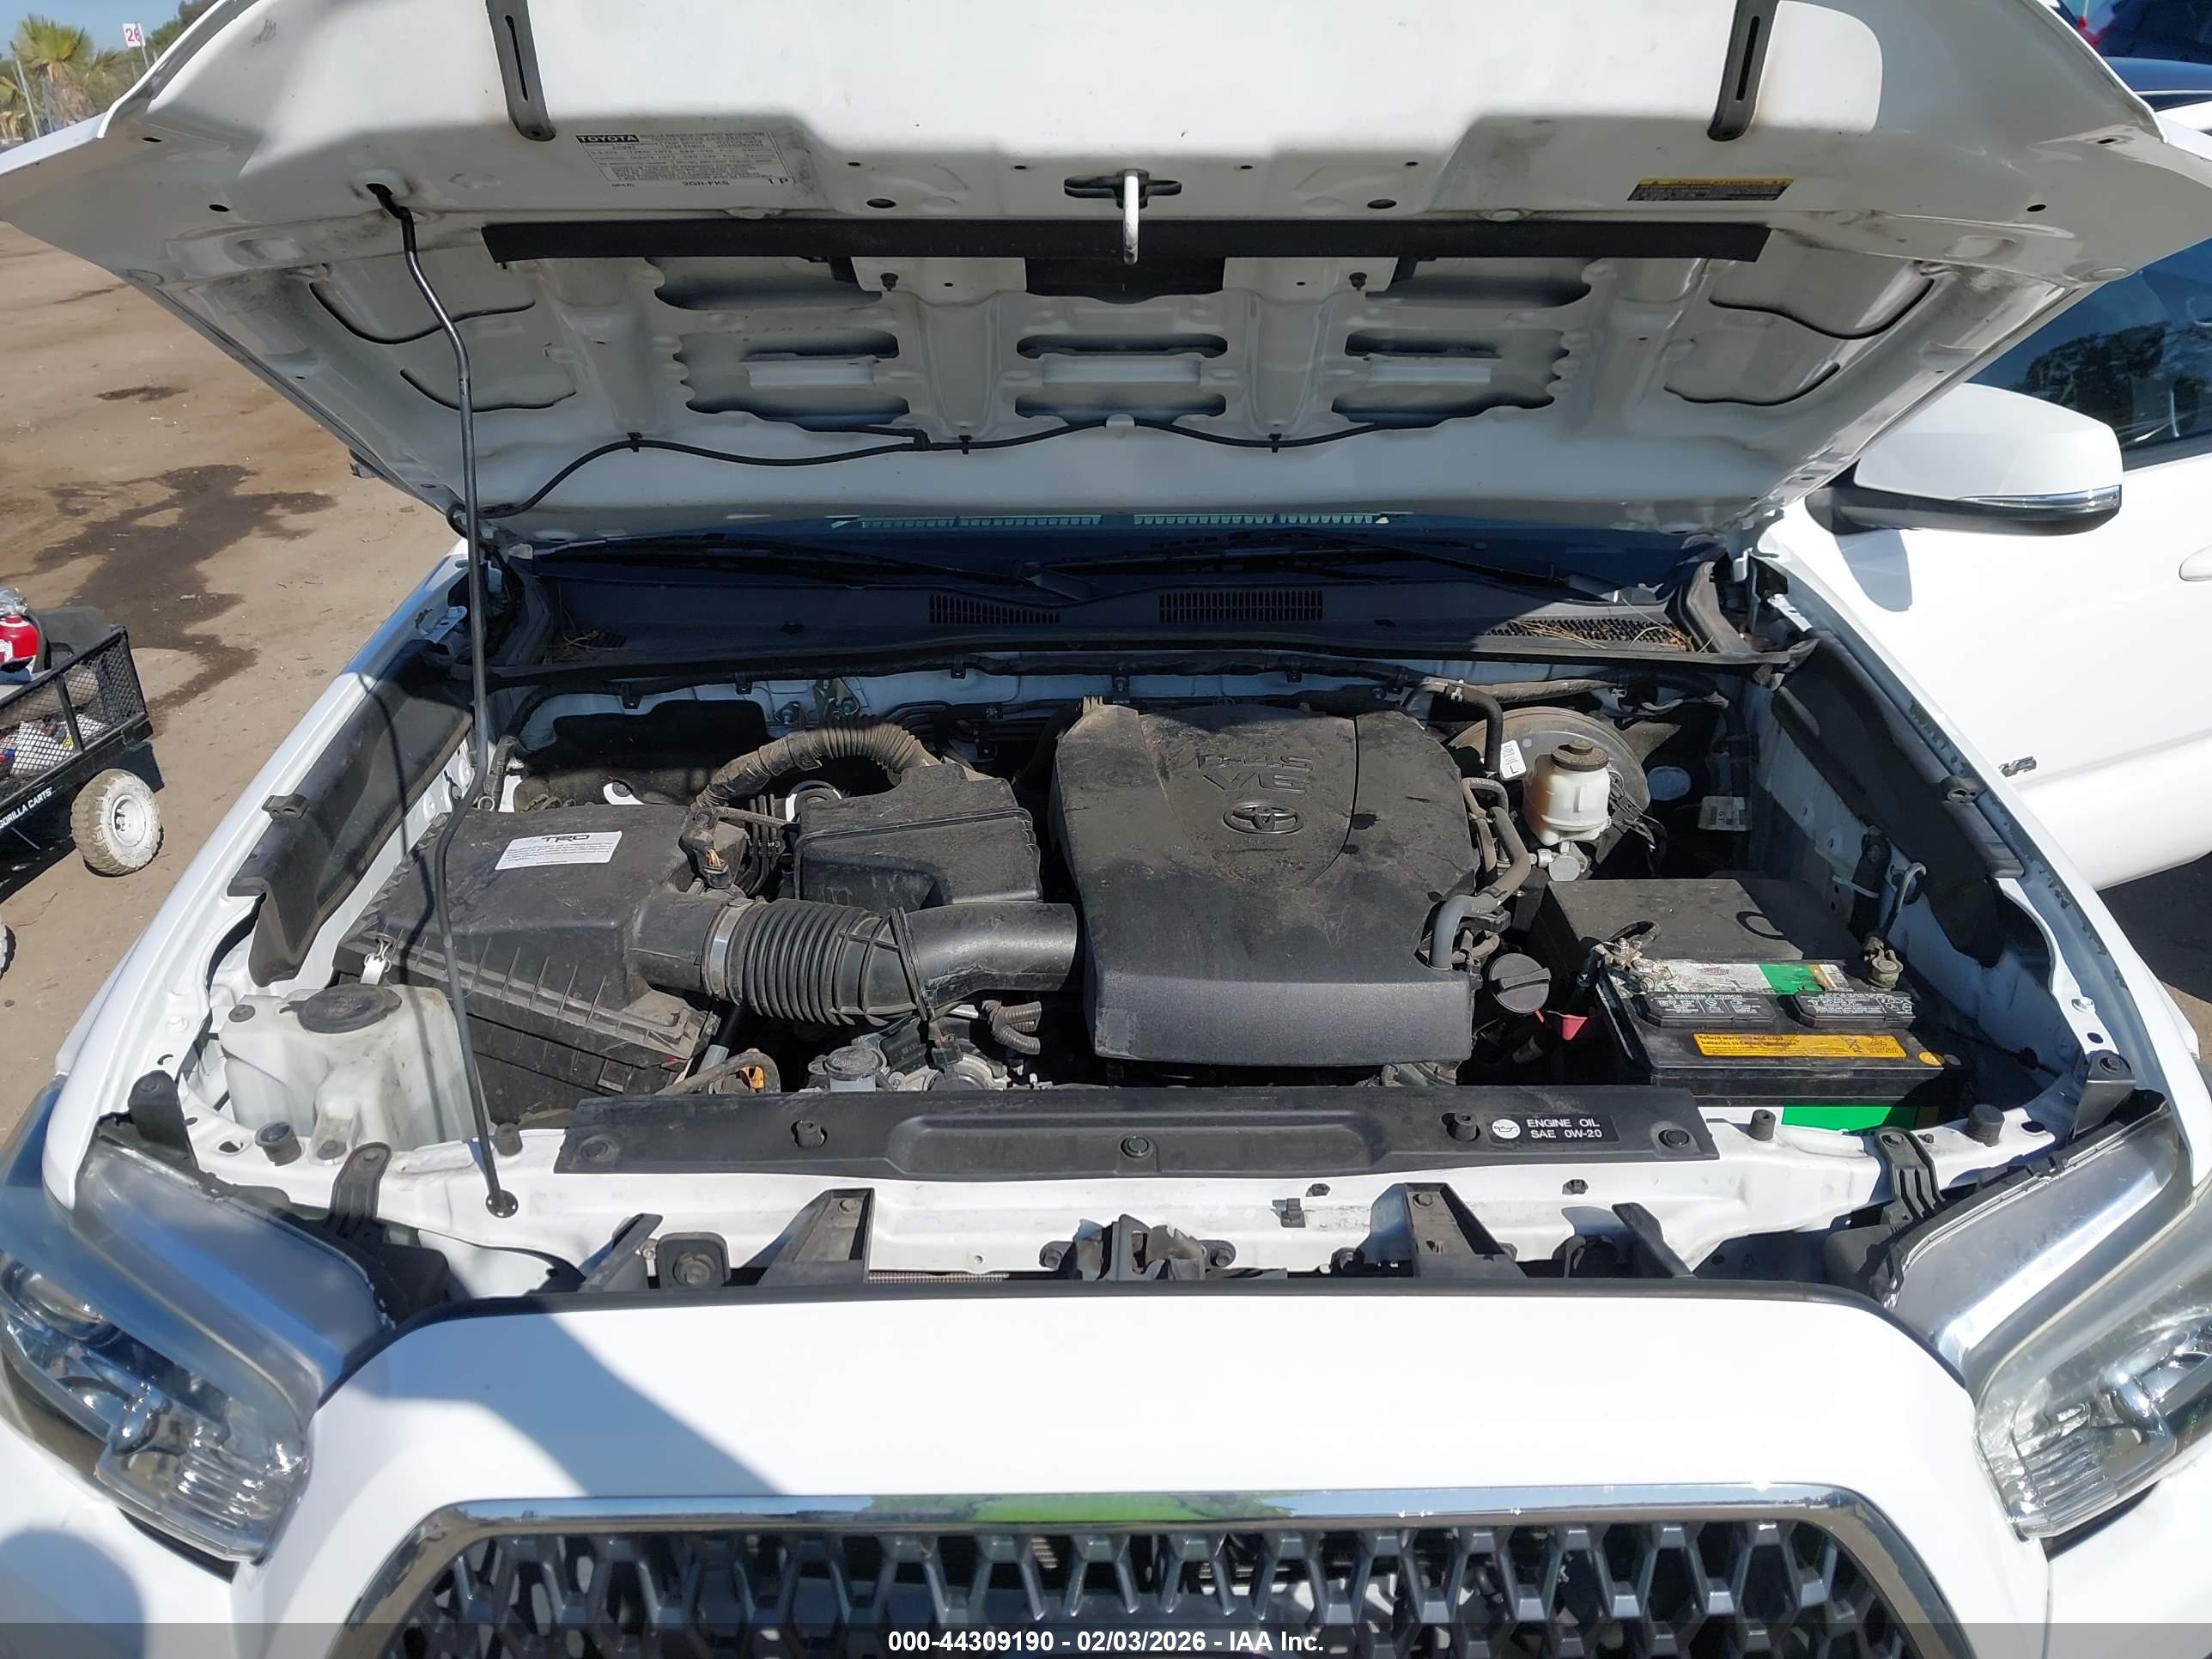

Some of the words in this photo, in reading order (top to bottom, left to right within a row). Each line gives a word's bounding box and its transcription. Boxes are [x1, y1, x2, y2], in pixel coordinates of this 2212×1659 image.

[27, 787, 52, 809] CARTS
[542, 834, 591, 842] TRD
[1527, 1119, 1571, 1127] ENGINE
[1579, 1118, 1600, 1127] OIL
[1531, 1129, 1556, 1139] SAE
[1565, 1129, 1602, 1139] 0W-20
